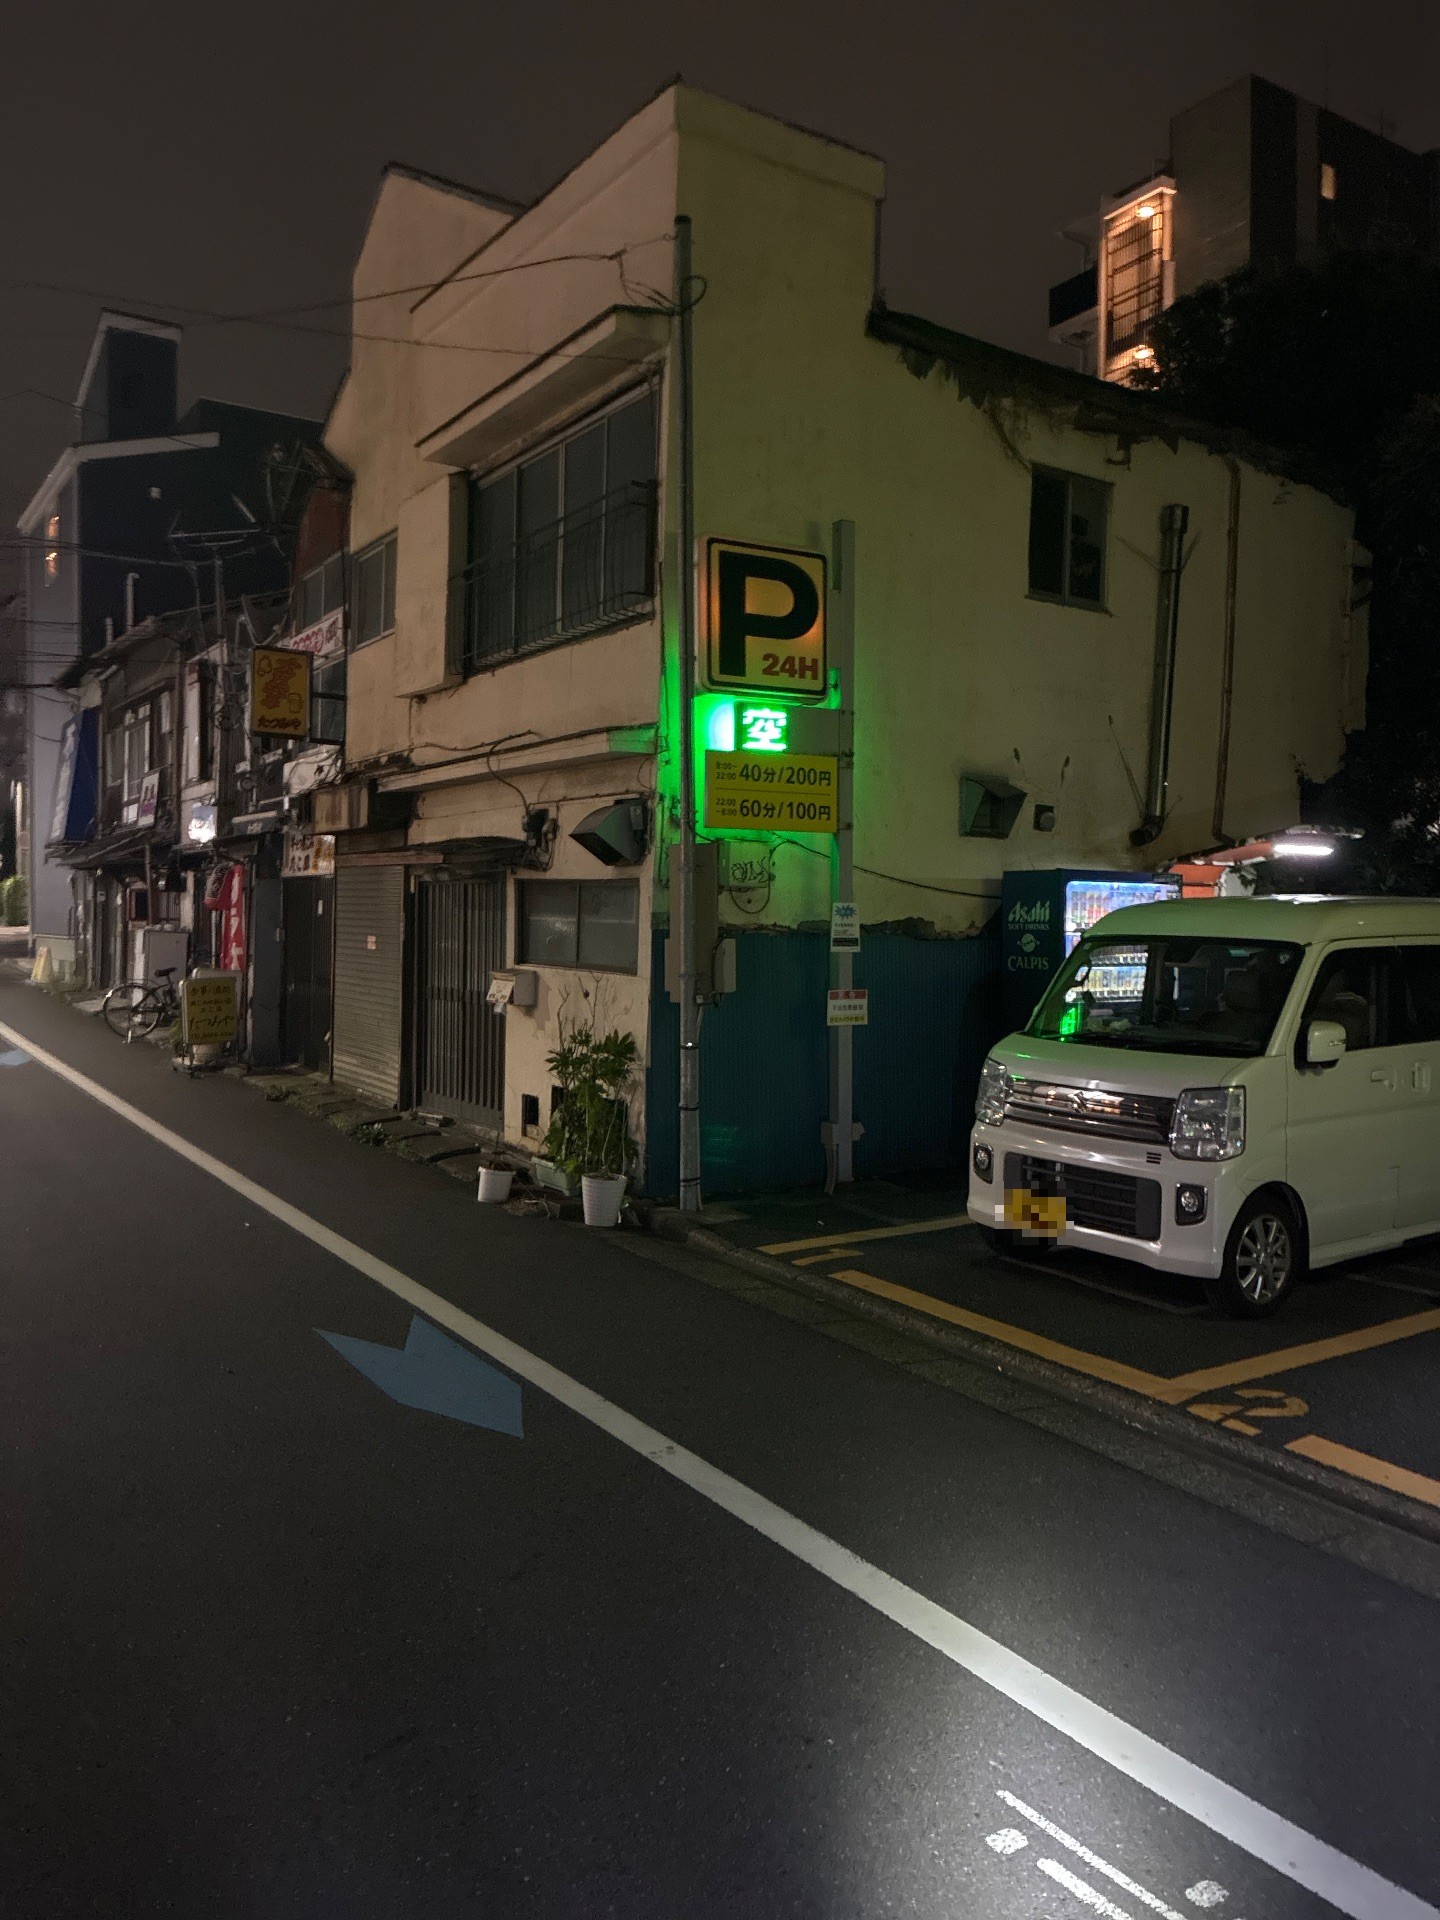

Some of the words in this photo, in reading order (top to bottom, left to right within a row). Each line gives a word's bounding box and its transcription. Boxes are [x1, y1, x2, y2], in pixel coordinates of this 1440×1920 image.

[719, 550, 819, 677] P
[761, 653, 819, 680] 24H
[742, 708, 787, 752] 空
[740, 763, 831, 787] 40分/200円
[715, 798, 737, 806] 22:00
[740, 800, 831, 820] 60分/100円
[1008, 901, 1050, 922] Asahi
[1007, 956, 1049, 971] CALPIS
[1186, 1388, 1311, 1436] 2
